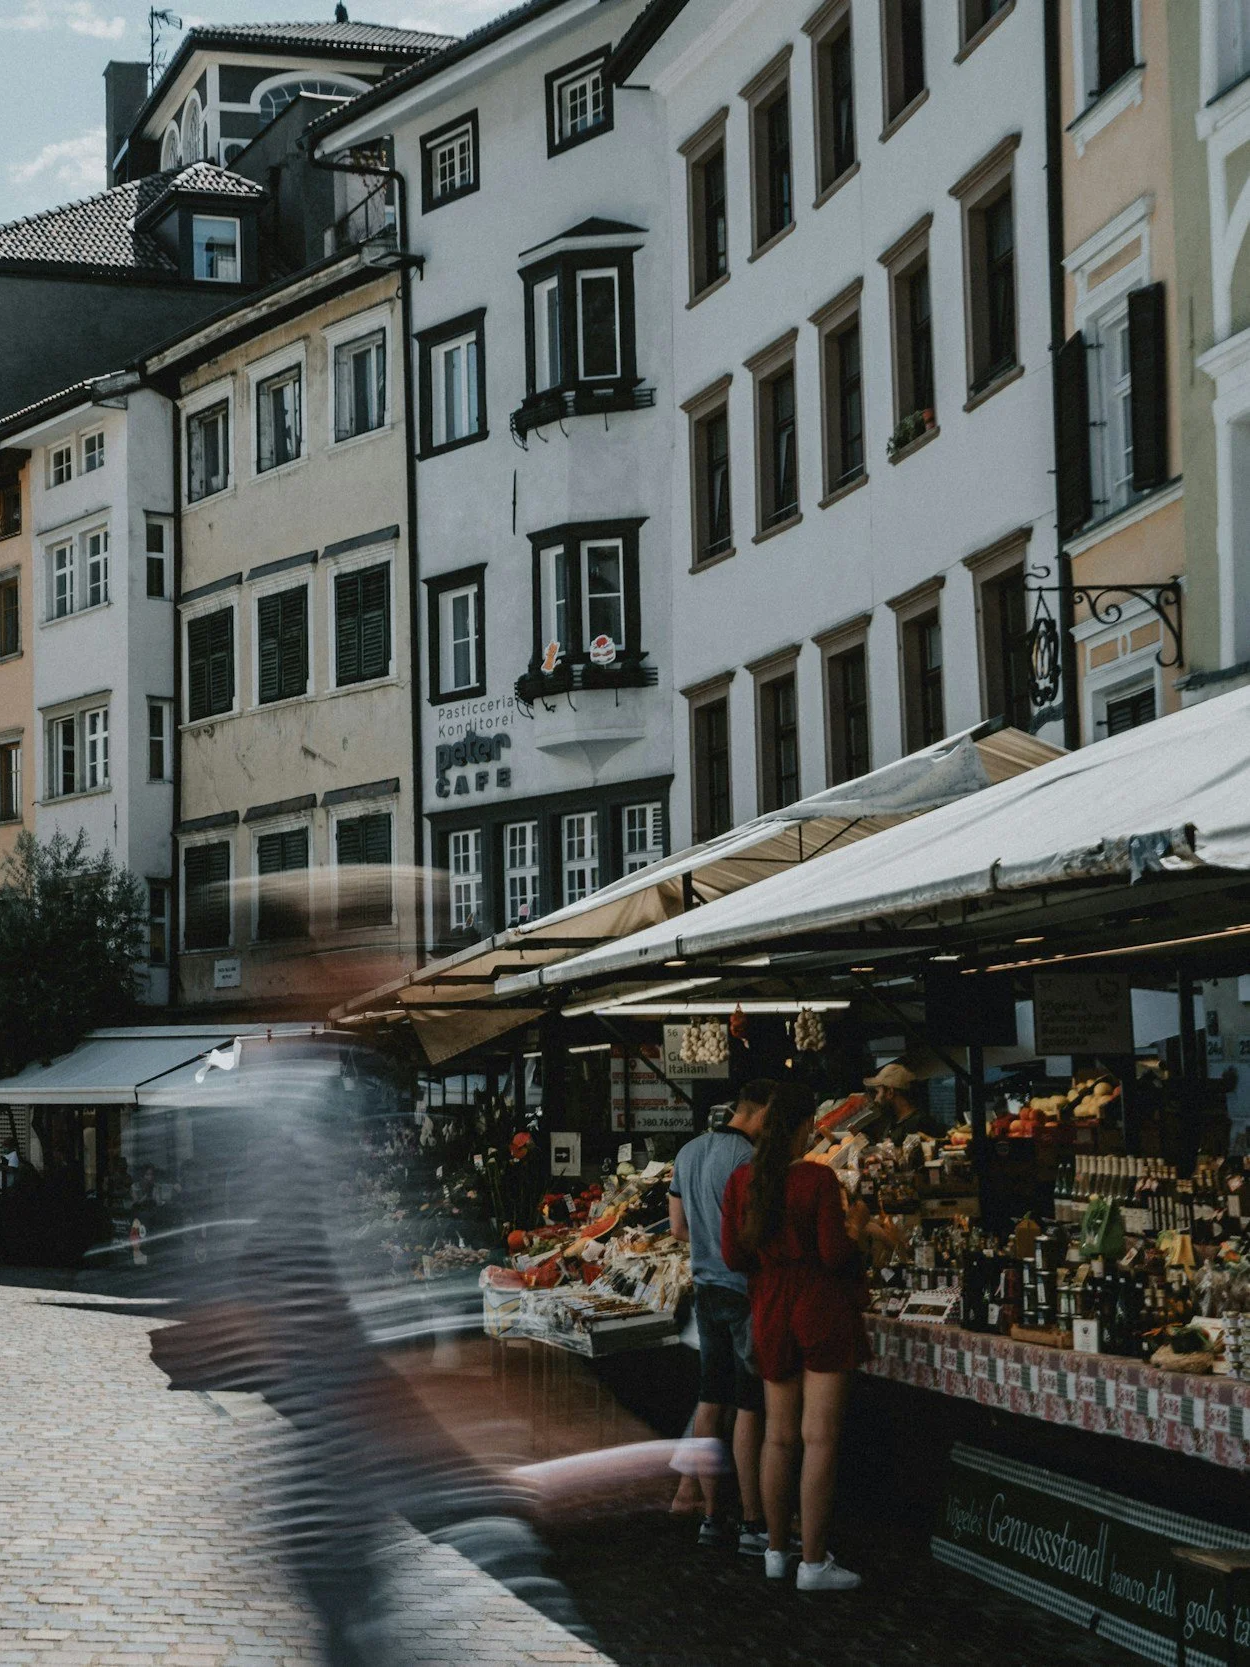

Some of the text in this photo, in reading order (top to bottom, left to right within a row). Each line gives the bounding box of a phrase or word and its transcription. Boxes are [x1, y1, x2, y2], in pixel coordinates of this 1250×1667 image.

[438, 695, 514, 721] Pasticceria
[438, 711, 514, 738] Konditorei
[435, 730, 512, 779] peter
[435, 767, 512, 799] CAFE
[667, 1028, 679, 1038] 56
[668, 1064, 708, 1075] Italiani
[986, 1492, 1110, 1588] Genussstandl
